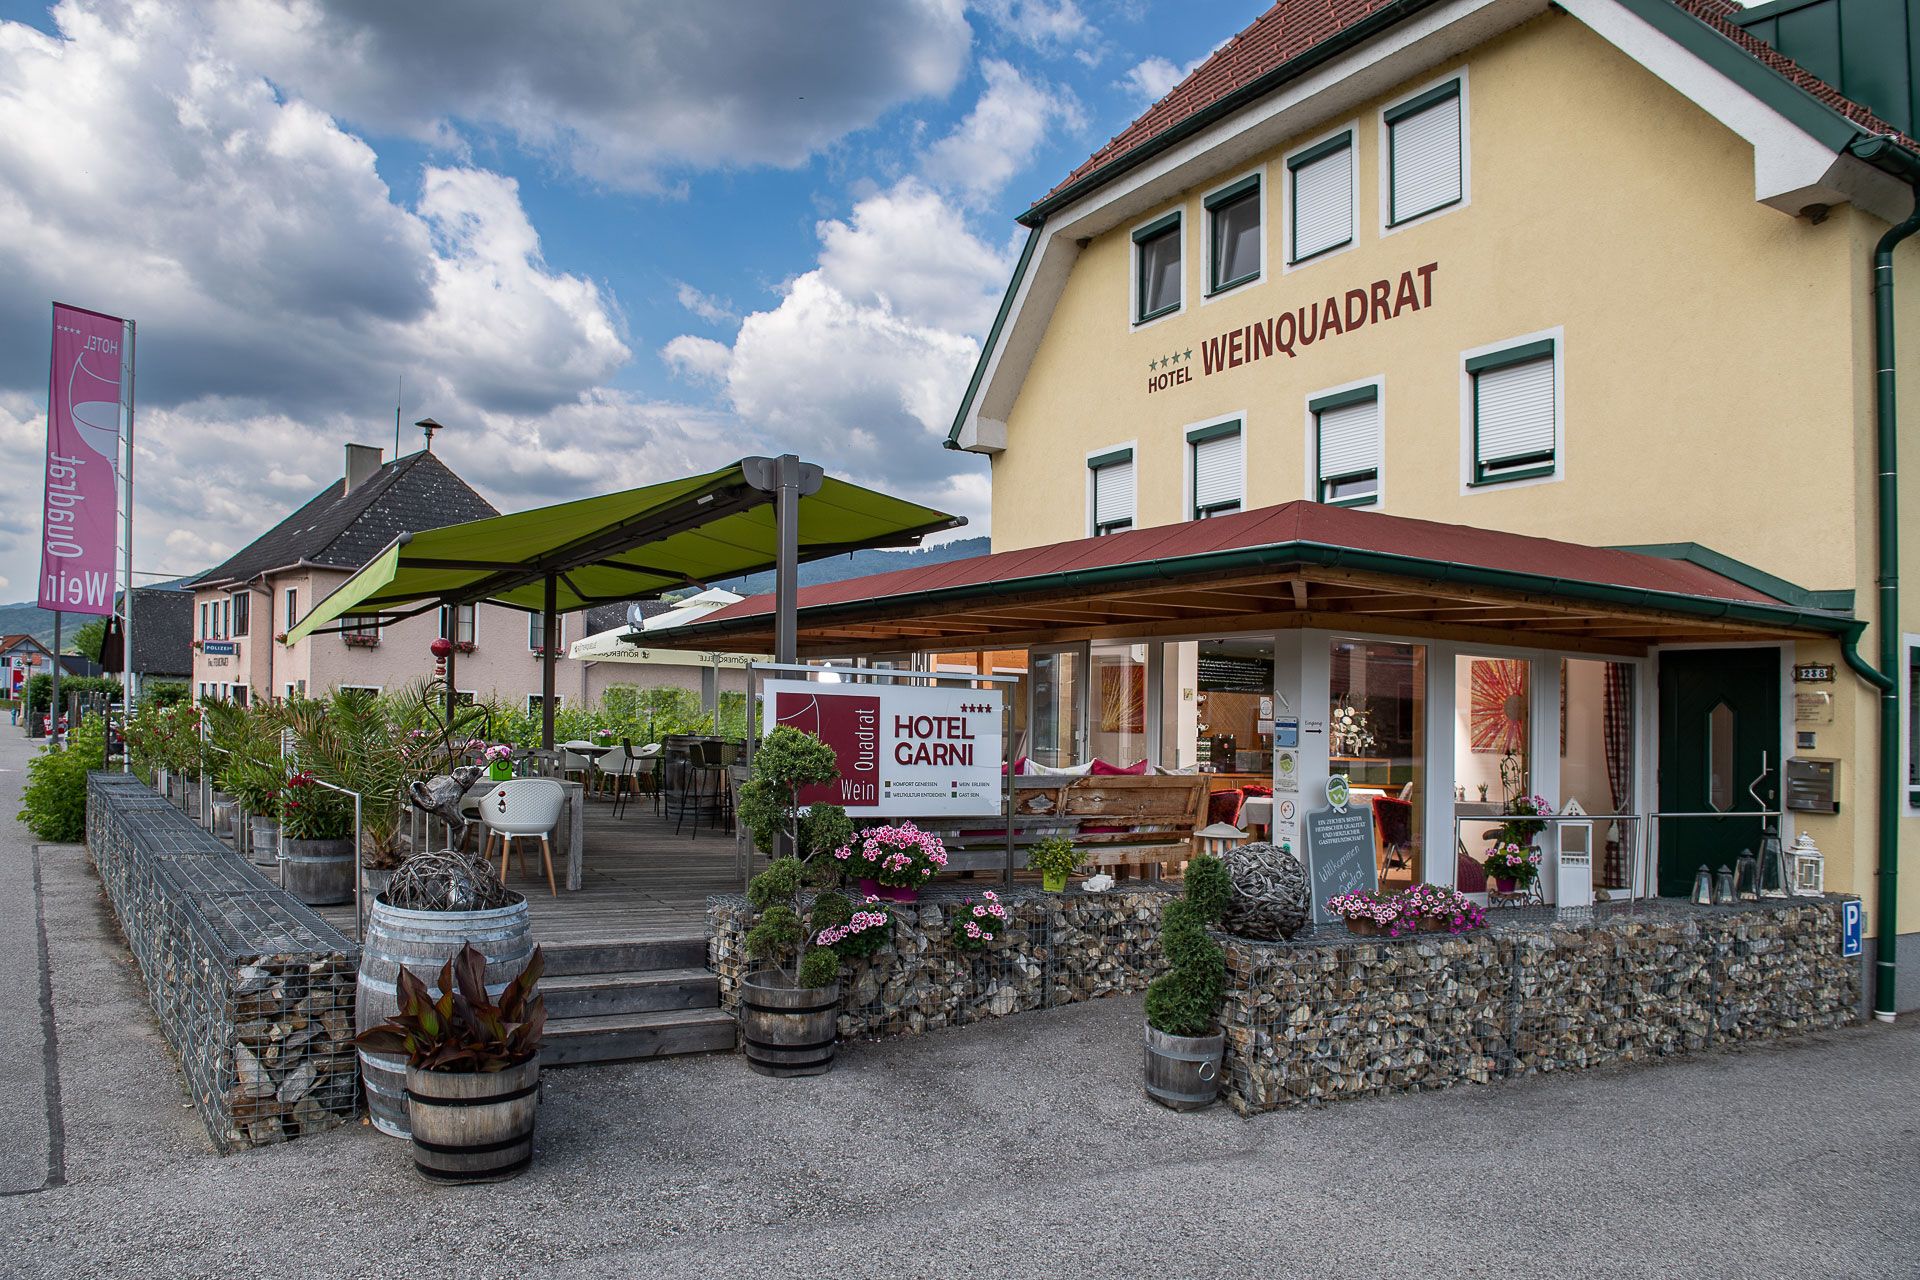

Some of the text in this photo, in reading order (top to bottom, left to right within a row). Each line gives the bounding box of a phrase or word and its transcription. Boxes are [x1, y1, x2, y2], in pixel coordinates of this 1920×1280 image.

[1148, 261, 1438, 394] HOTEL WEINQUADRAT
[854, 708, 875, 771] Quadrat
[894, 715, 975, 740] HOTEL
[894, 742, 974, 766] GARNI
[840, 778, 874, 800] Wein
[1315, 824, 1344, 833] HEIMISCHER
[1327, 817, 1346, 825] ZEICHEN
[1346, 815, 1363, 823] BESTER
[1318, 834, 1365, 845] GASTFREUNDSCHAFT
[1318, 845, 1361, 883] Willkommen
[1846, 905, 1859, 936] P
